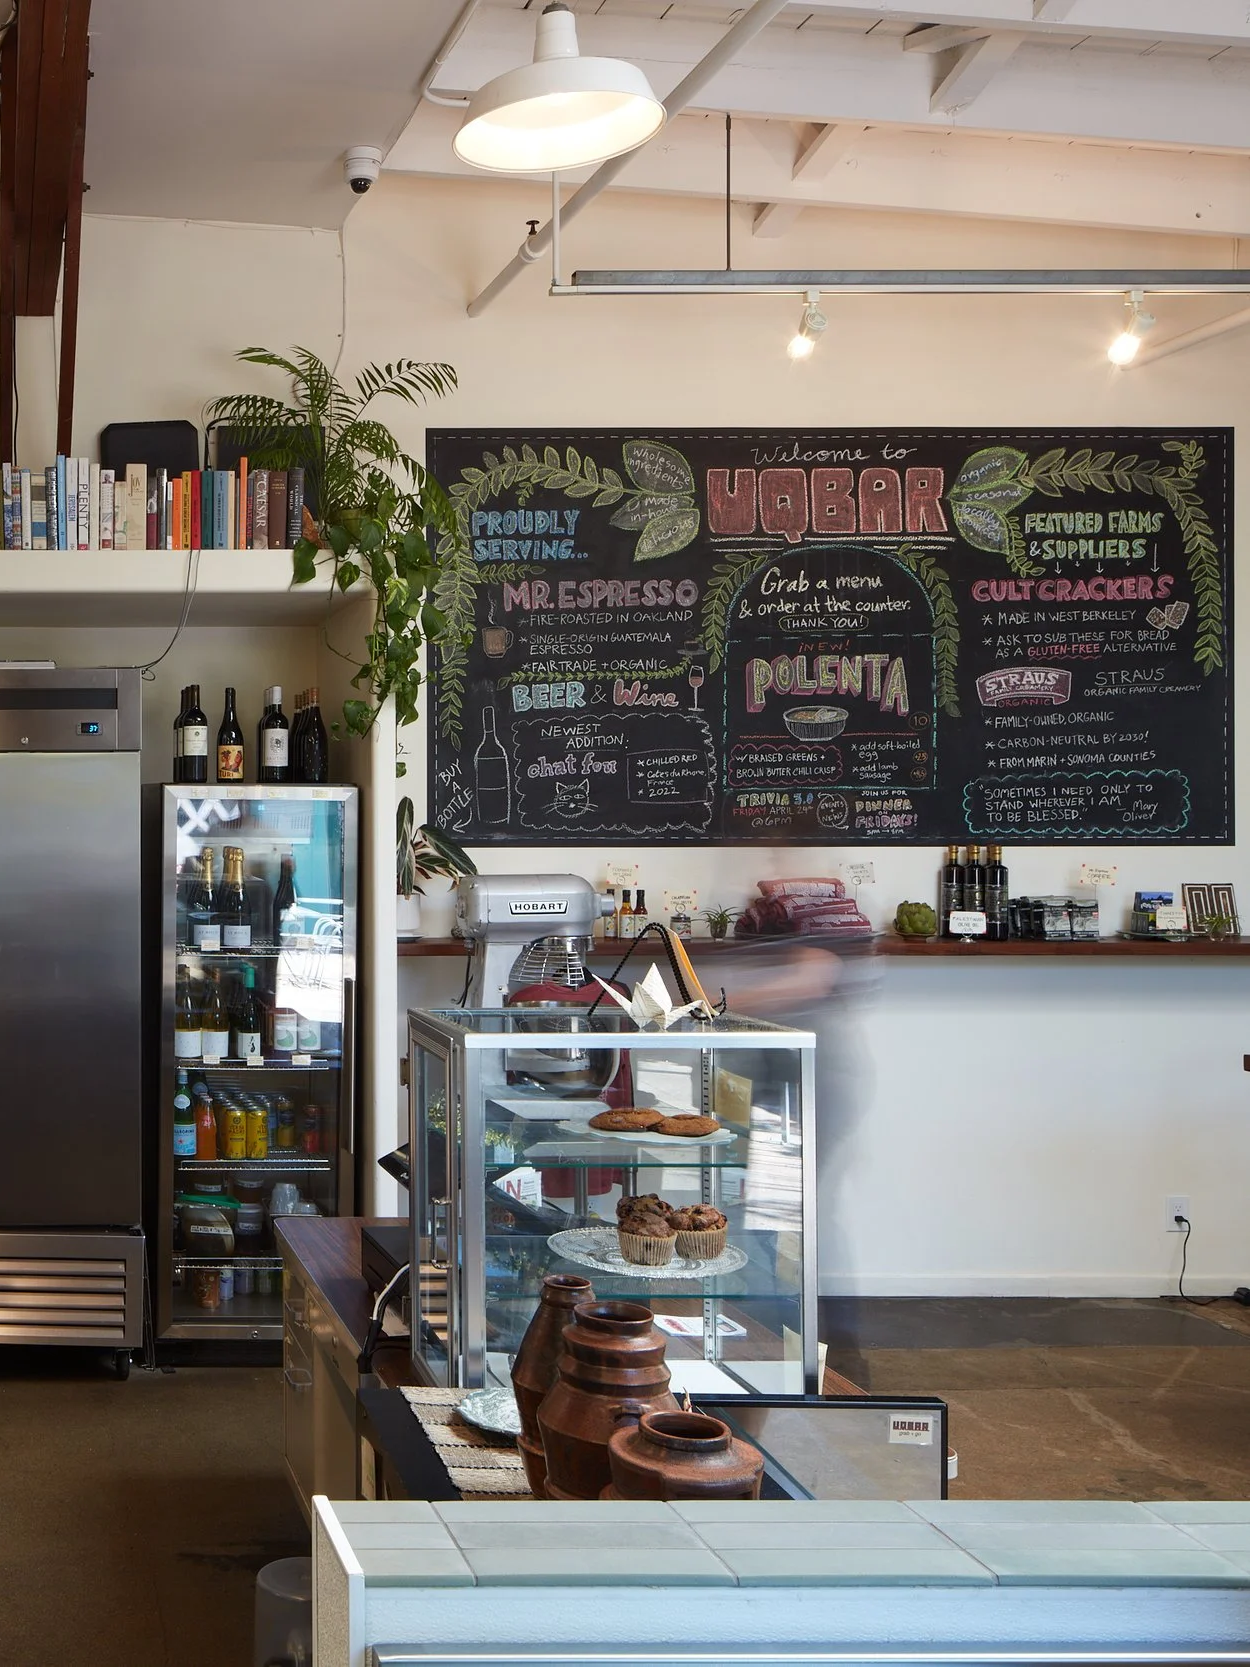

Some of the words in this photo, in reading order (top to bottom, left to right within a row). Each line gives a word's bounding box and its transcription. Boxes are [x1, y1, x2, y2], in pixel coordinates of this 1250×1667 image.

[751, 443, 870, 465] Welcome
[881, 443, 917, 460] to
[628, 457, 683, 490] ingredients
[634, 448, 690, 485] wholesome
[961, 459, 1001, 482] organic
[645, 496, 678, 506] made
[966, 486, 1022, 501] seasonal
[68, 494, 76, 521] JERUSALEM
[79, 484, 88, 529] PLENTY
[256, 481, 267, 528] CAESAR
[707, 467, 948, 543] UQBAR
[472, 509, 580, 535] PROUDLY
[1024, 512, 1103, 534] FEATURED
[1109, 512, 1164, 533] FARMS
[760, 566, 809, 595] Grab
[816, 578, 828, 589] a
[835, 574, 884, 588] menu
[972, 579, 1035, 602] CULT
[1036, 574, 1174, 601] CRACKERS
[558, 579, 698, 608] ESPRESSO
[739, 600, 752, 618] &
[758, 600, 801, 615] order
[805, 600, 821, 613] at
[825, 599, 851, 612] the
[530, 613, 613, 626] FIRE-ROASTED
[616, 612, 629, 623] IN
[633, 610, 693, 622] OAKLAND
[786, 617, 827, 628] THANK
[830, 615, 865, 627] YOU!
[998, 612, 1030, 625] MADE
[1034, 611, 1046, 622] IN
[1049, 611, 1080, 622] WEST
[1082, 609, 1136, 621] BERKELEY
[530, 633, 609, 645] SINGLE-ORIGIN
[610, 632, 671, 642] GUATEMALA
[997, 632, 1020, 645] ASK
[1024, 631, 1042, 643] TO
[1044, 631, 1067, 643] SUB
[1069, 632, 1104, 643] THESE
[1110, 630, 1131, 642] FOR
[1138, 629, 1170, 641] BREAD
[530, 643, 592, 655] ESPRESSO
[996, 648, 1012, 658] AS
[1014, 648, 1023, 656] A
[1028, 643, 1100, 657] GLUTEN-FREE
[1104, 642, 1177, 652] ALTERNATIVE
[985, 672, 1059, 693] STRAUS
[1095, 669, 1164, 685] STRAUS
[745, 654, 909, 716] POLENTA
[1084, 686, 1127, 696] ORGANIC
[1129, 685, 1157, 694] FAMILY
[512, 680, 586, 712] BEER
[591, 685, 606, 704] &
[613, 678, 679, 707] Wine
[998, 698, 1050, 708] ORGANIC
[914, 716, 927, 725] 10
[541, 723, 600, 737] NEWEST
[859, 741, 876, 750] add
[878, 739, 920, 750] soft-boiled
[997, 734, 1099, 749] CARBON-NEUTRAL
[1103, 733, 1116, 743] BY
[1119, 730, 1149, 743] 2030!
[646, 755, 680, 766] CHILLED
[681, 754, 697, 763] RED
[749, 753, 783, 763] BRAISED
[786, 753, 817, 761] GREENS
[859, 751, 878, 762] egg
[1000, 757, 1026, 768] FROM
[1027, 755, 1057, 767] MARIN
[1067, 754, 1105, 766] SONOMA
[1108, 750, 1156, 762] COUNTIES
[439, 758, 463, 786] BUY
[527, 755, 577, 778] chat
[581, 752, 617, 774] fou
[793, 767, 812, 778] CHILI
[814, 766, 836, 775] CRISP
[860, 764, 876, 772] add
[879, 762, 898, 770] lamb
[860, 772, 891, 783] sausage
[452, 782, 461, 792] A
[649, 787, 680, 797] 2022
[1063, 785, 1092, 796] NEED
[1101, 783, 1131, 794] ONLY
[1136, 783, 1153, 792] TO
[737, 792, 789, 807] TRIVIA
[794, 793, 813, 805] 3.0
[855, 799, 912, 812] DINNER
[985, 800, 1023, 810] STAND
[1030, 797, 1084, 808] WHEREVER
[1099, 795, 1121, 806] AM
[1133, 800, 1158, 813] Mary
[437, 787, 474, 829] BOTTLE
[733, 807, 766, 816] FRIDAY
[770, 806, 794, 814] APRIL
[855, 814, 918, 828] FRIDAYS!
[987, 812, 1005, 822] TO
[1007, 811, 1021, 821] BE
[1122, 810, 1156, 822] Oliver
